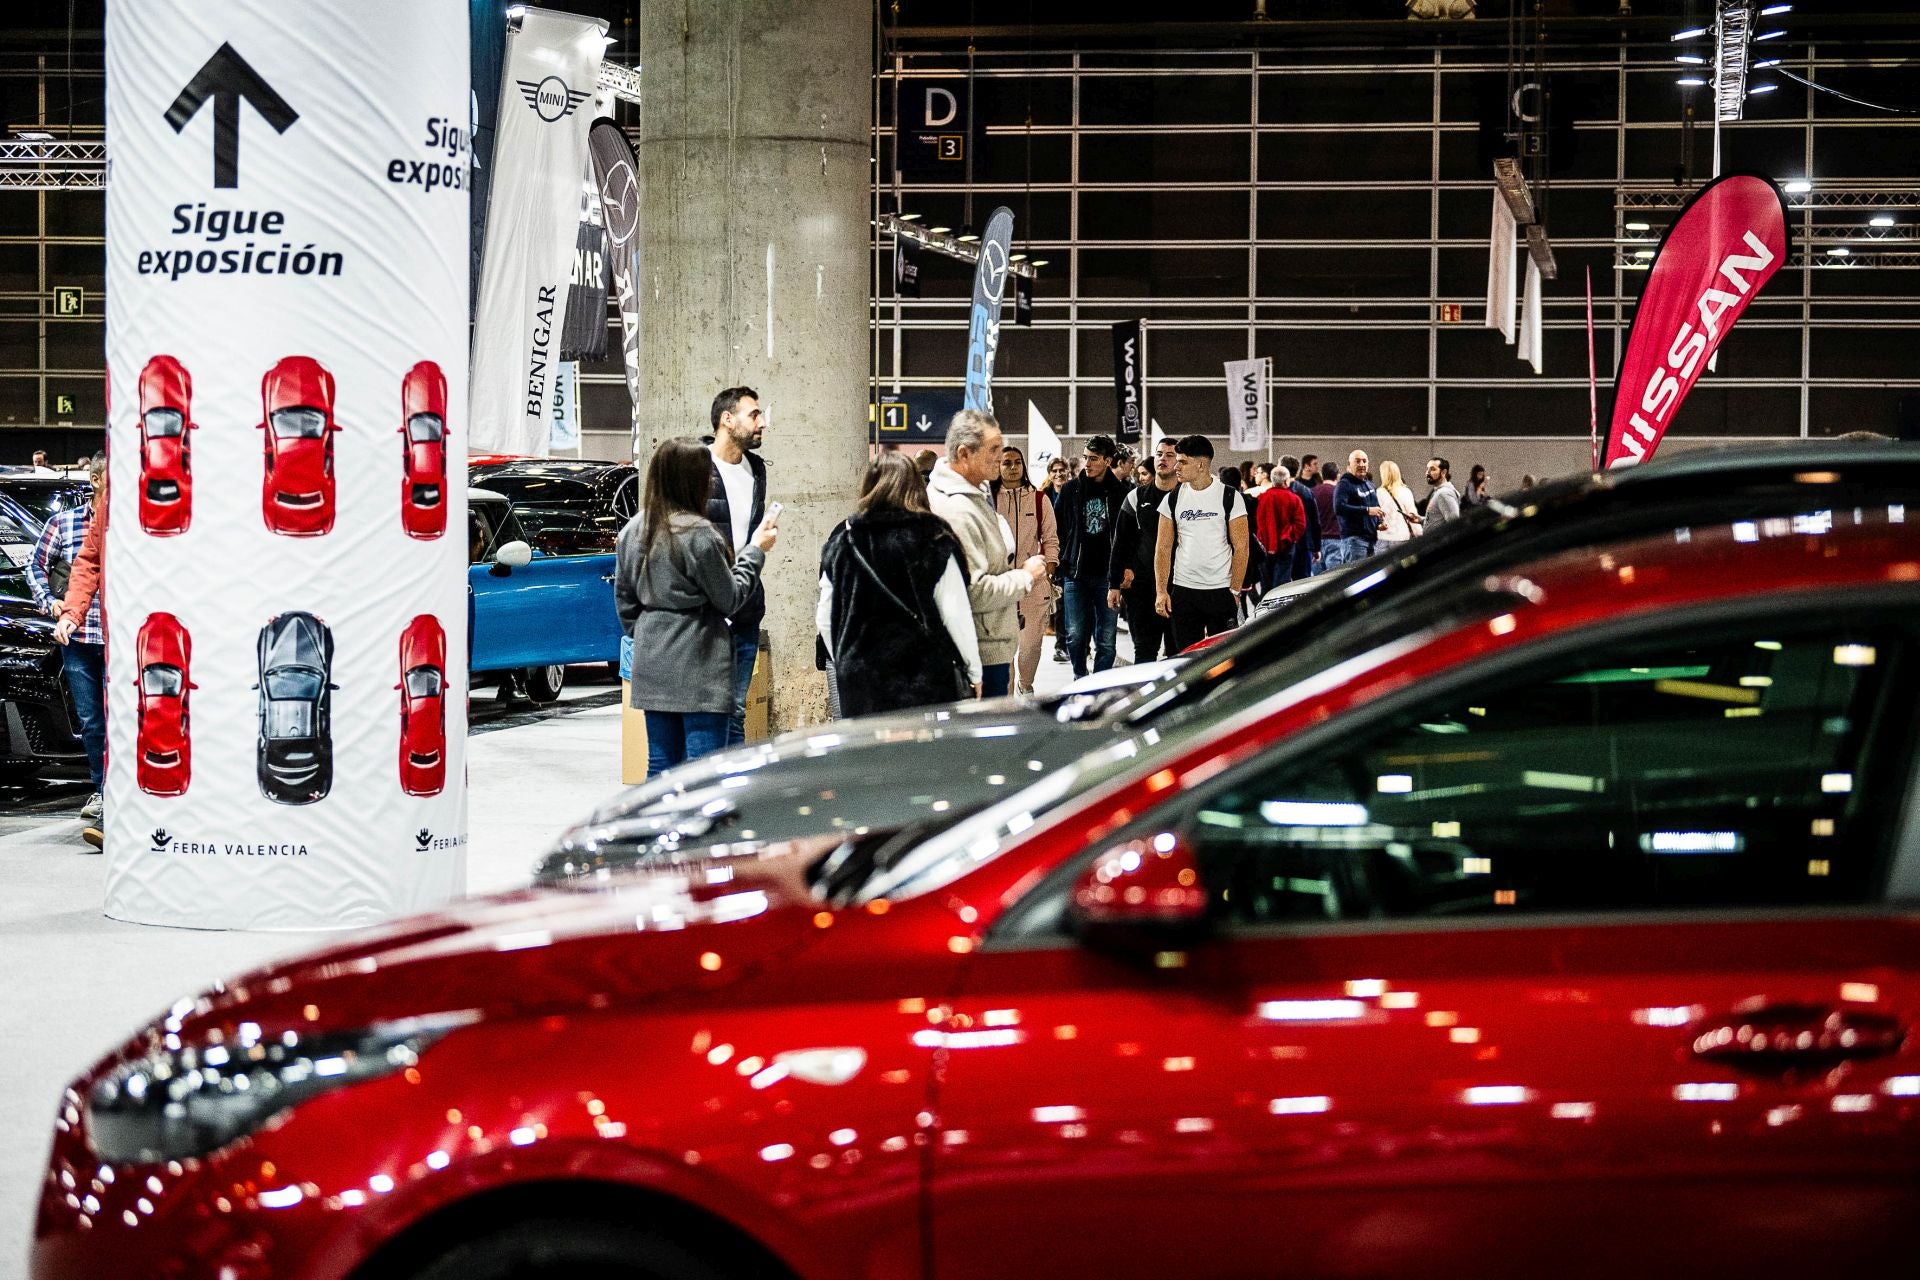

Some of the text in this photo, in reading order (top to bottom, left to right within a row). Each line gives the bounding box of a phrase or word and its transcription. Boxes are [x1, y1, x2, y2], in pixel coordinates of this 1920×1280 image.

[539, 92, 564, 107] MINI
[925, 88, 957, 126] D
[1512, 83, 1542, 122] C
[945, 140, 956, 155] 3
[172, 203, 284, 241] Sigue
[138, 243, 343, 281] exposición
[527, 285, 556, 419] BENIGAR
[886, 408, 897, 426] 1
[173, 842, 308, 855] FERIA VALENCIA
